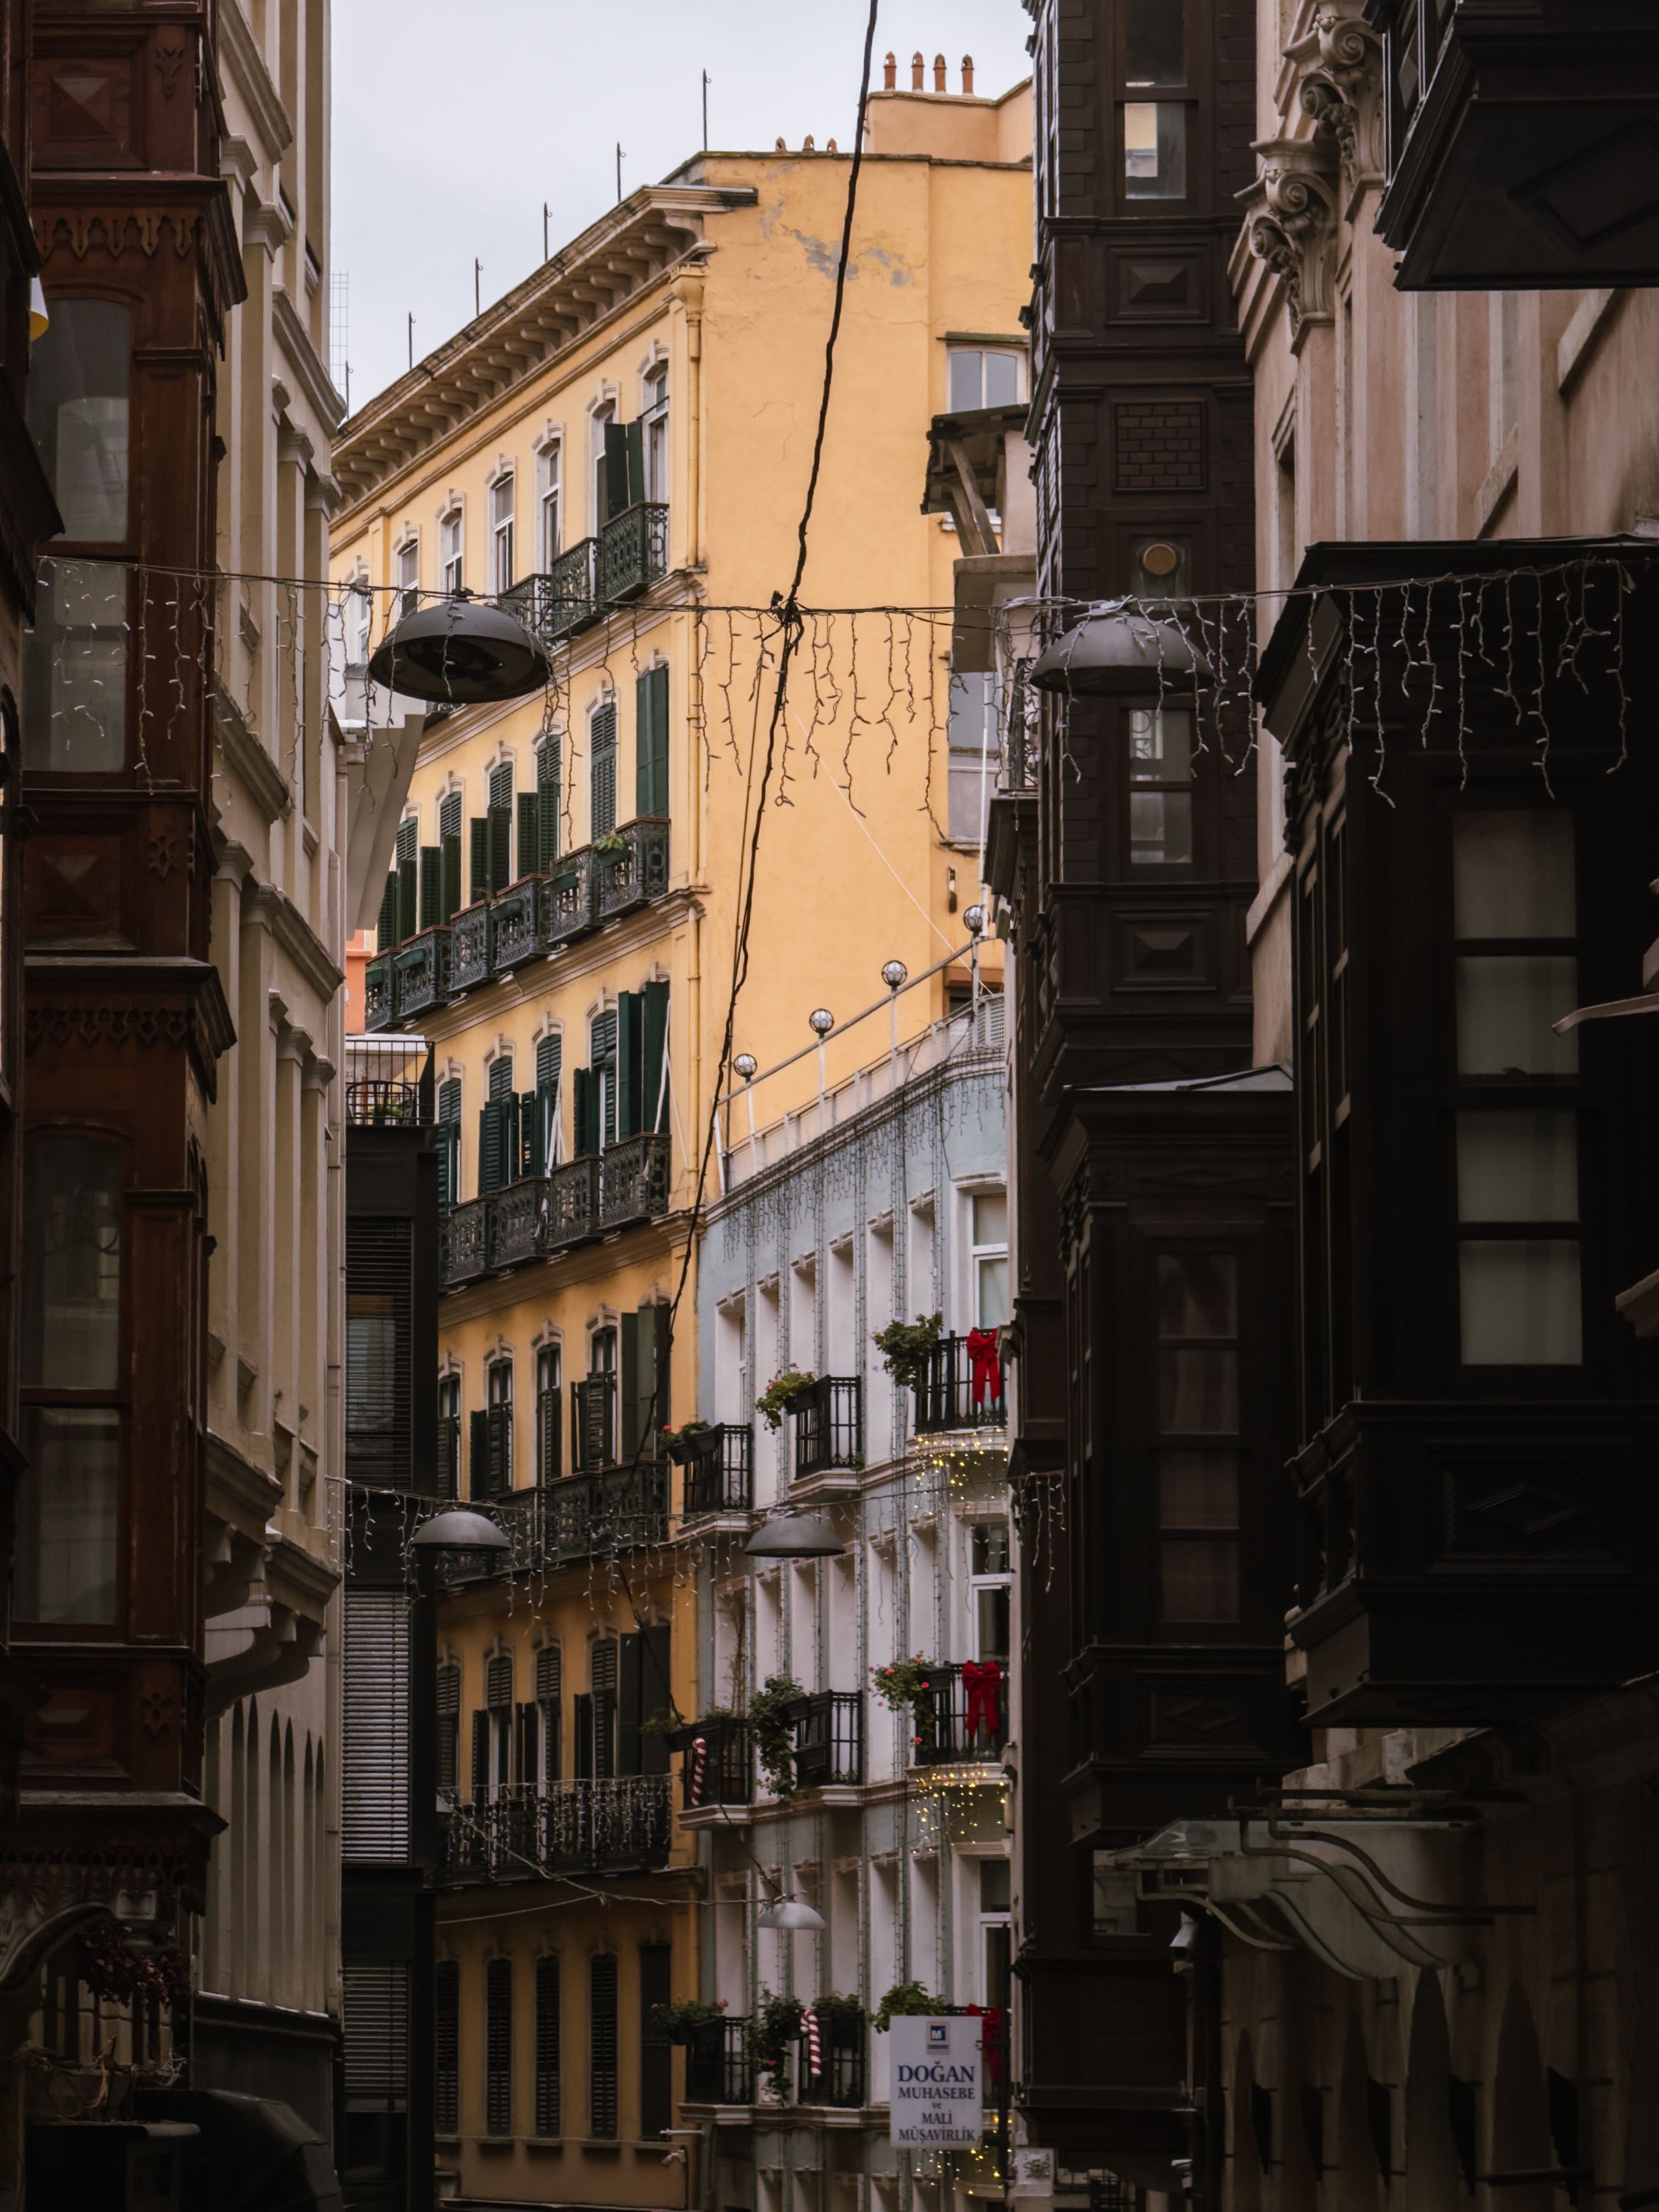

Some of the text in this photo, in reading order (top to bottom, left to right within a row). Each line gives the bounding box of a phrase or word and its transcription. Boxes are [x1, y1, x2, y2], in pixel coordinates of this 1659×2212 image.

[898, 2061, 974, 2083] DOĞAN
[898, 2087, 975, 2099] MUHASEBE
[922, 2111, 952, 2124] MALİ
[899, 2126, 975, 2143] MÜŞAVİRLİK
